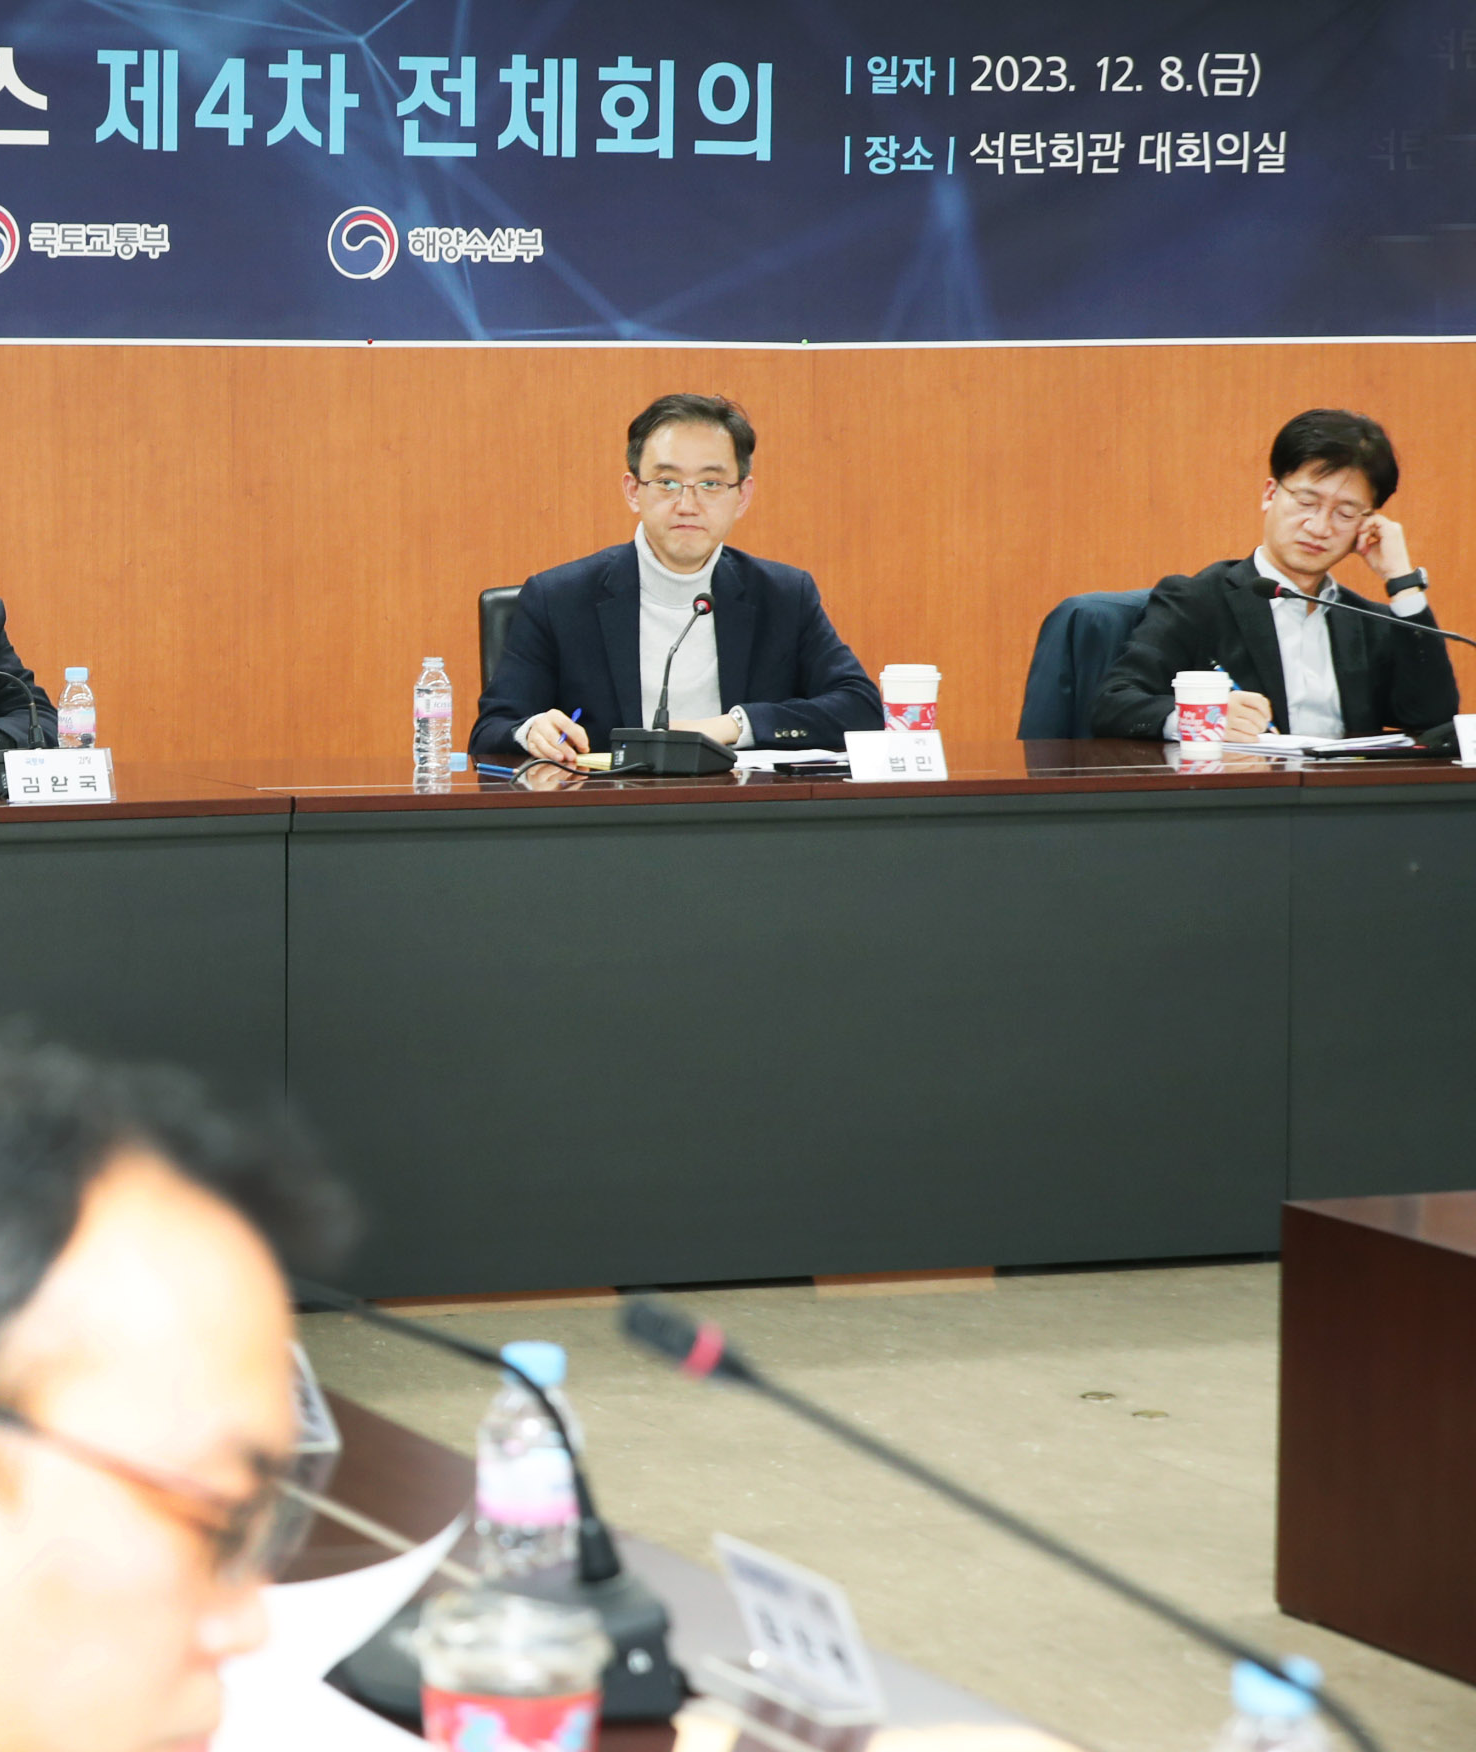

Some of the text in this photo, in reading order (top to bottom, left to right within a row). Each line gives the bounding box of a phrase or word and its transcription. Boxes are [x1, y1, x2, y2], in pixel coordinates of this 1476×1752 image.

[867, 53, 1260, 97] 일자 2023. 12. 8.(금)
[96, 49, 359, 154] 제4차
[397, 55, 772, 161] 전체회의
[865, 132, 1286, 174] 장소 석탄회관 대회의실
[29, 223, 170, 260] 국토교통부
[408, 227, 543, 265] 해양수산부
